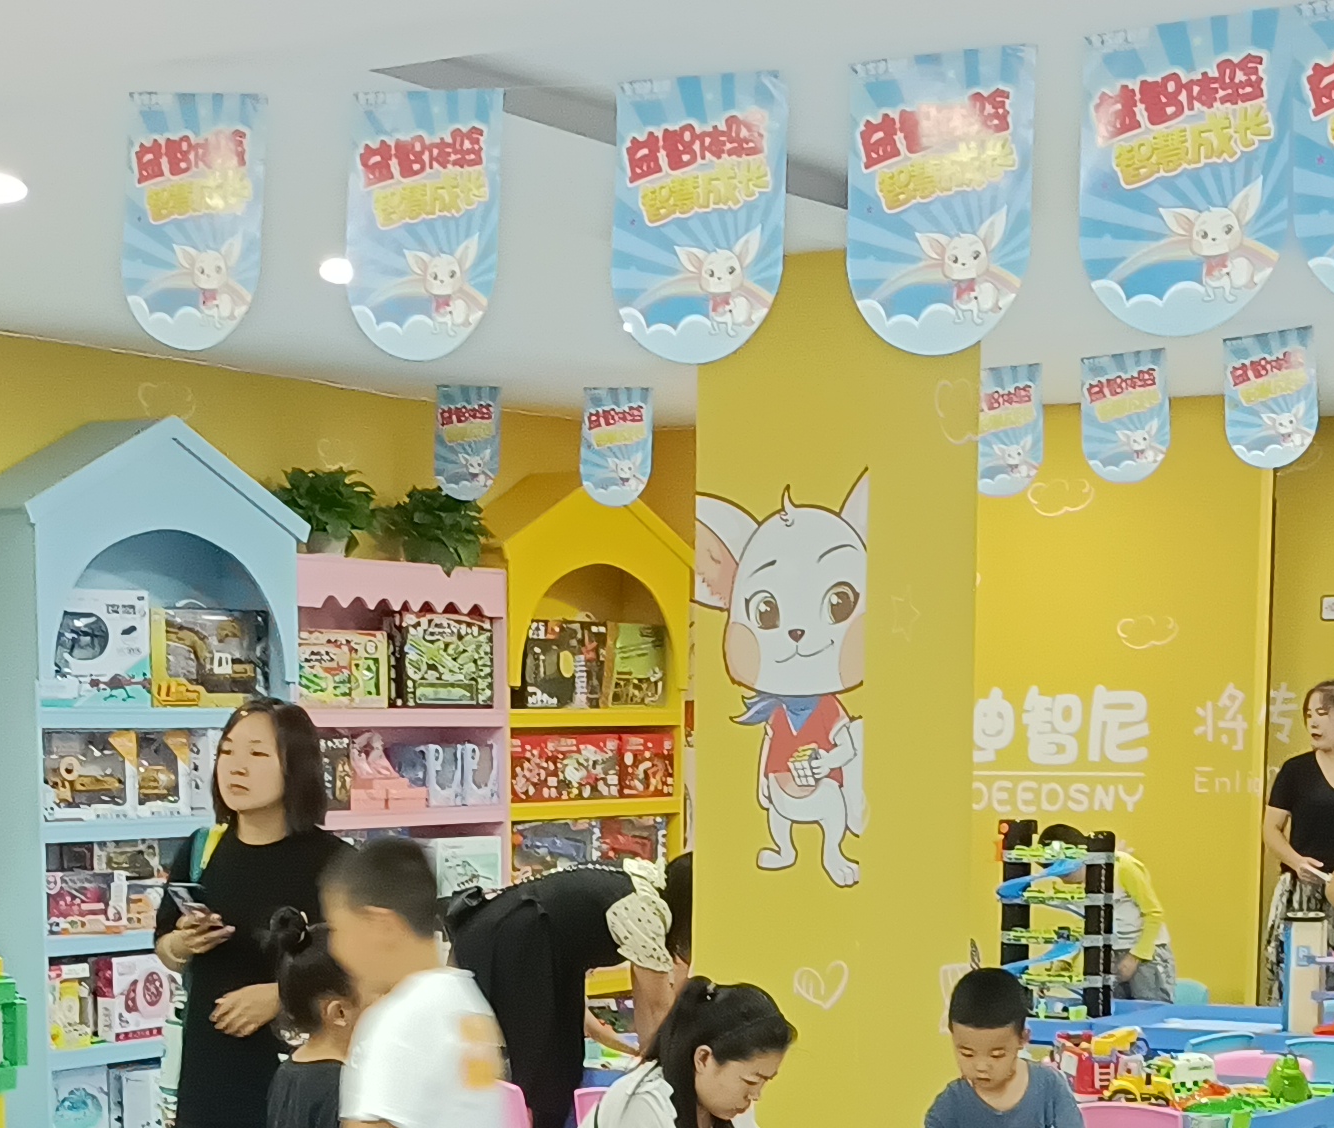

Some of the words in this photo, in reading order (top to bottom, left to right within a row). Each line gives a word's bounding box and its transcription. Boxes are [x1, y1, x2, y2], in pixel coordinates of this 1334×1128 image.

[1094, 53, 1264, 146] 益智体验
[1115, 105, 1271, 186] 智慧成长
